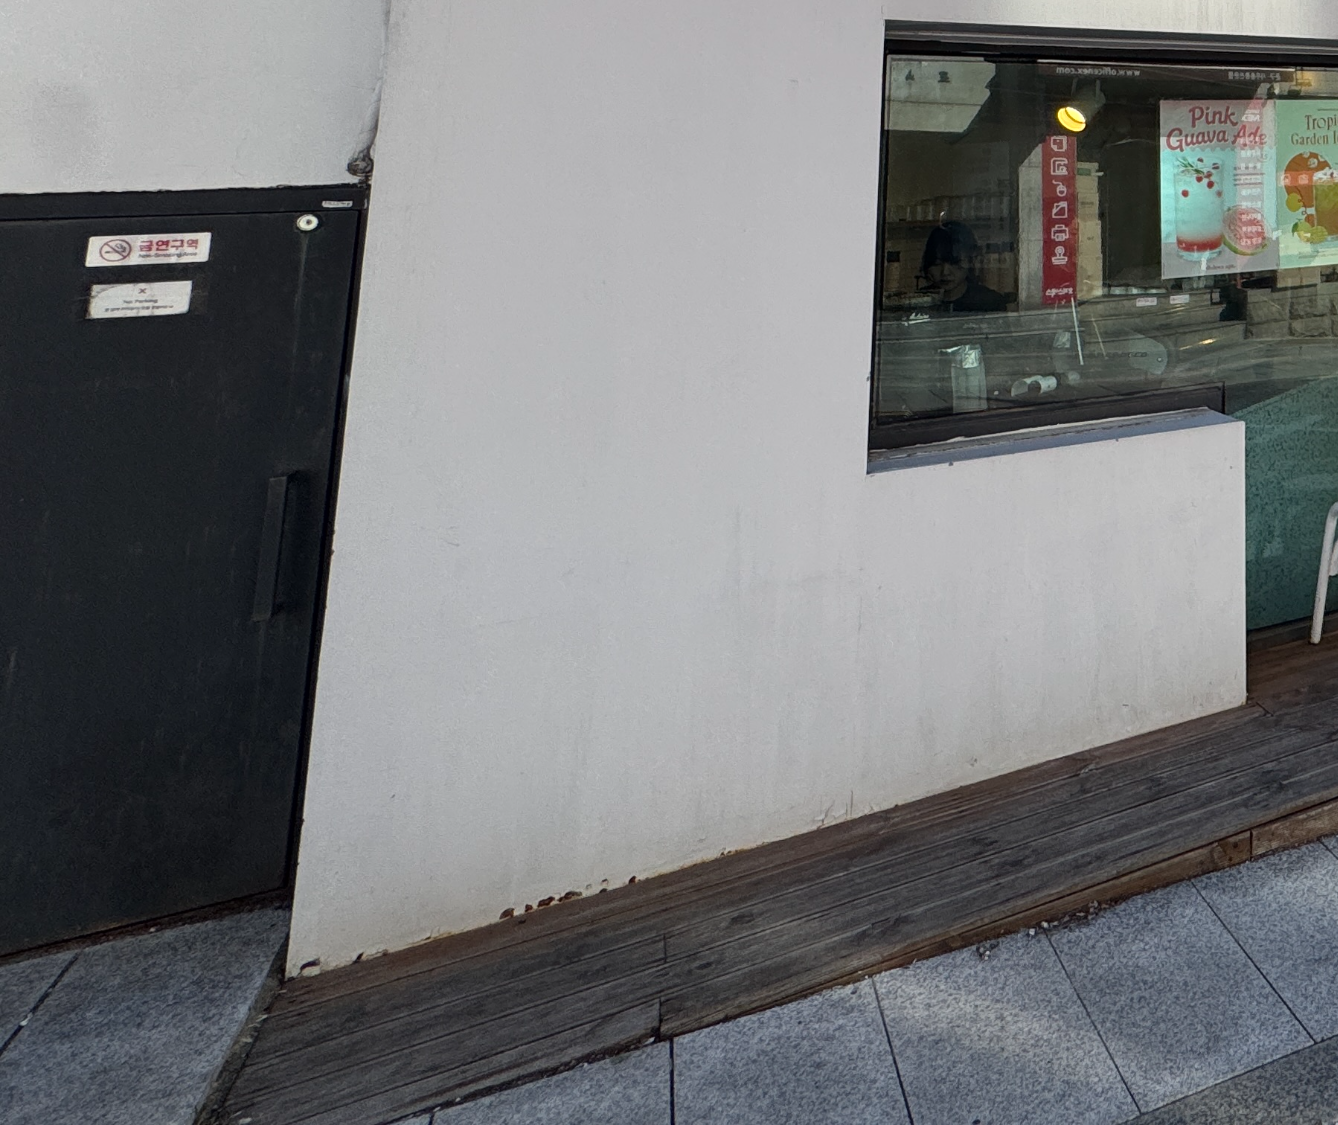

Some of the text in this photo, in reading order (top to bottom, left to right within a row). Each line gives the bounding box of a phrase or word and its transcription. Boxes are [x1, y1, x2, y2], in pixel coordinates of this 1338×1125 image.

[1188, 105, 1239, 128] Pink
[1166, 124, 1268, 152] Guava Ade
[1290, 132, 1329, 146] Garden
[138, 238, 199, 252] 금연구역
